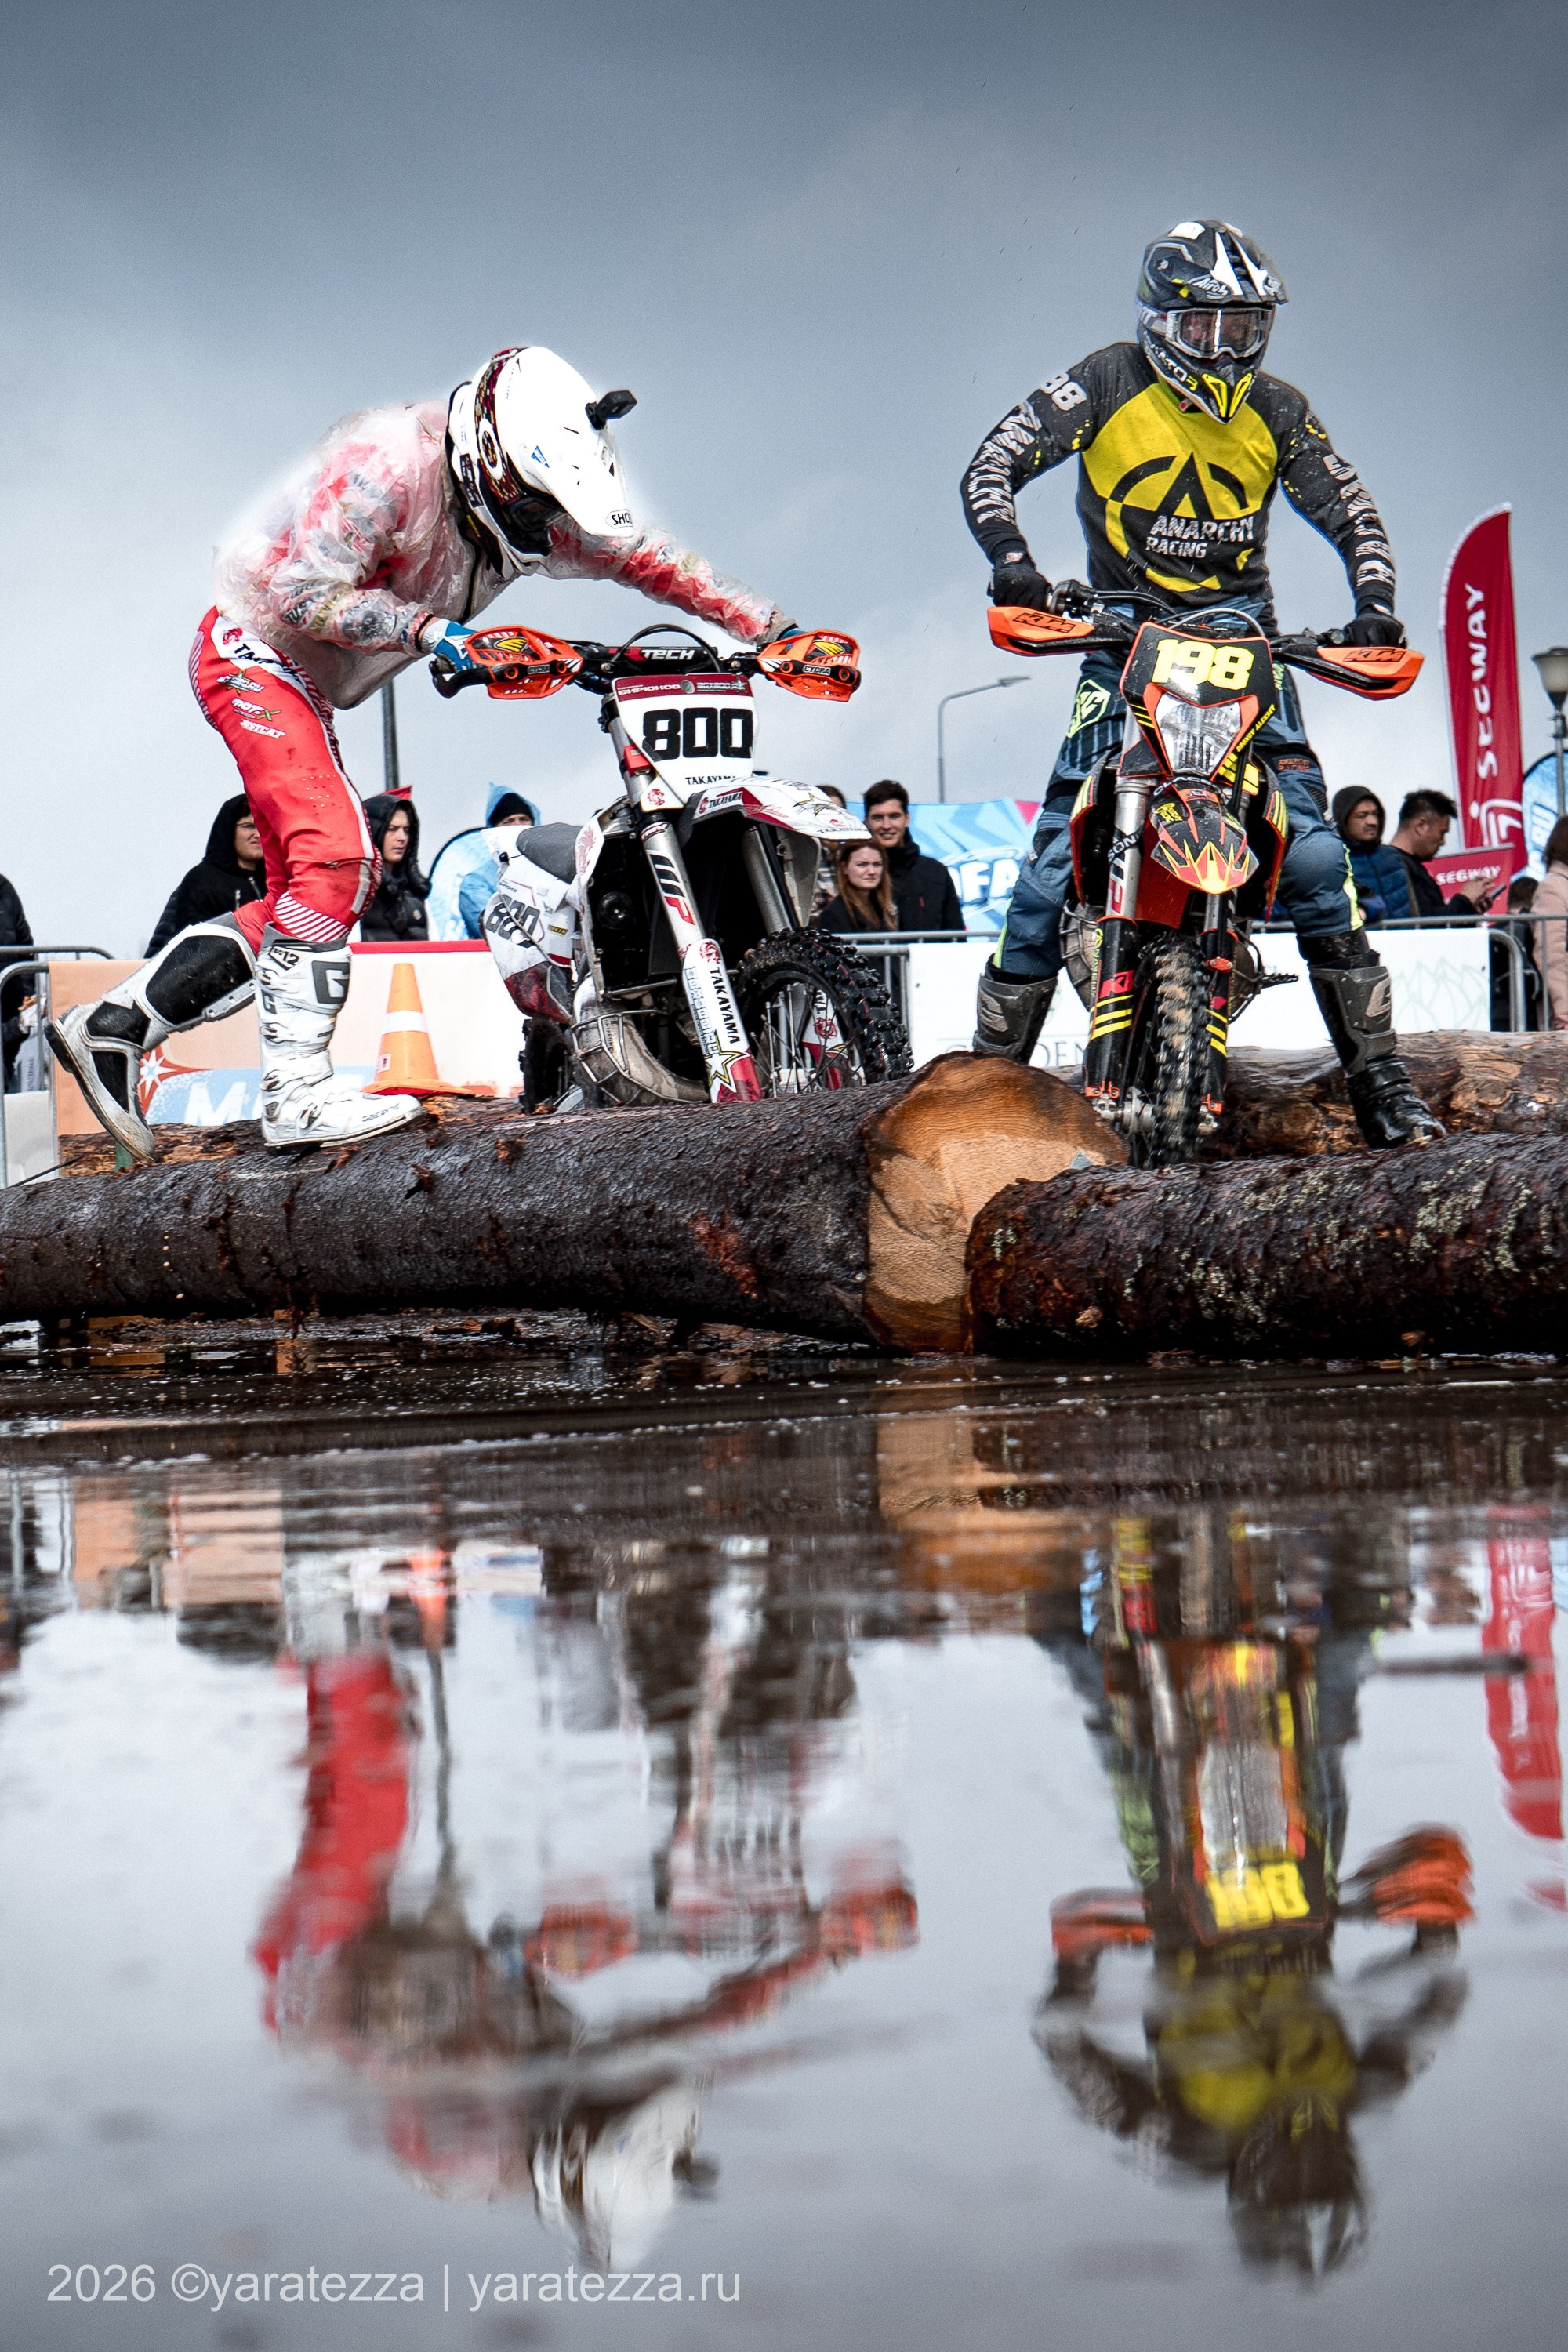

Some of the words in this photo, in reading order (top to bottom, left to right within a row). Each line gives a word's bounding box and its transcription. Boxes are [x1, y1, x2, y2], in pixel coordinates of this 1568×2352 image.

[1150, 516, 1254, 542] ANARCHY
[1145, 536, 1208, 558] RACING
[1013, 612, 1076, 633] KTM
[1152, 638, 1254, 691] 198
[1343, 648, 1406, 662] KTM
[804, 665, 831, 675] CYCRA
[1465, 583, 1499, 780] SEGWAY
[618, 684, 681, 695] БИРЮКОВ
[641, 707, 754, 763] 800
[1436, 865, 1501, 886] SEGWAY
[486, 893, 541, 942] 800
[1099, 970, 1135, 998] KT
[710, 967, 741, 1044] TAKAYAMA
